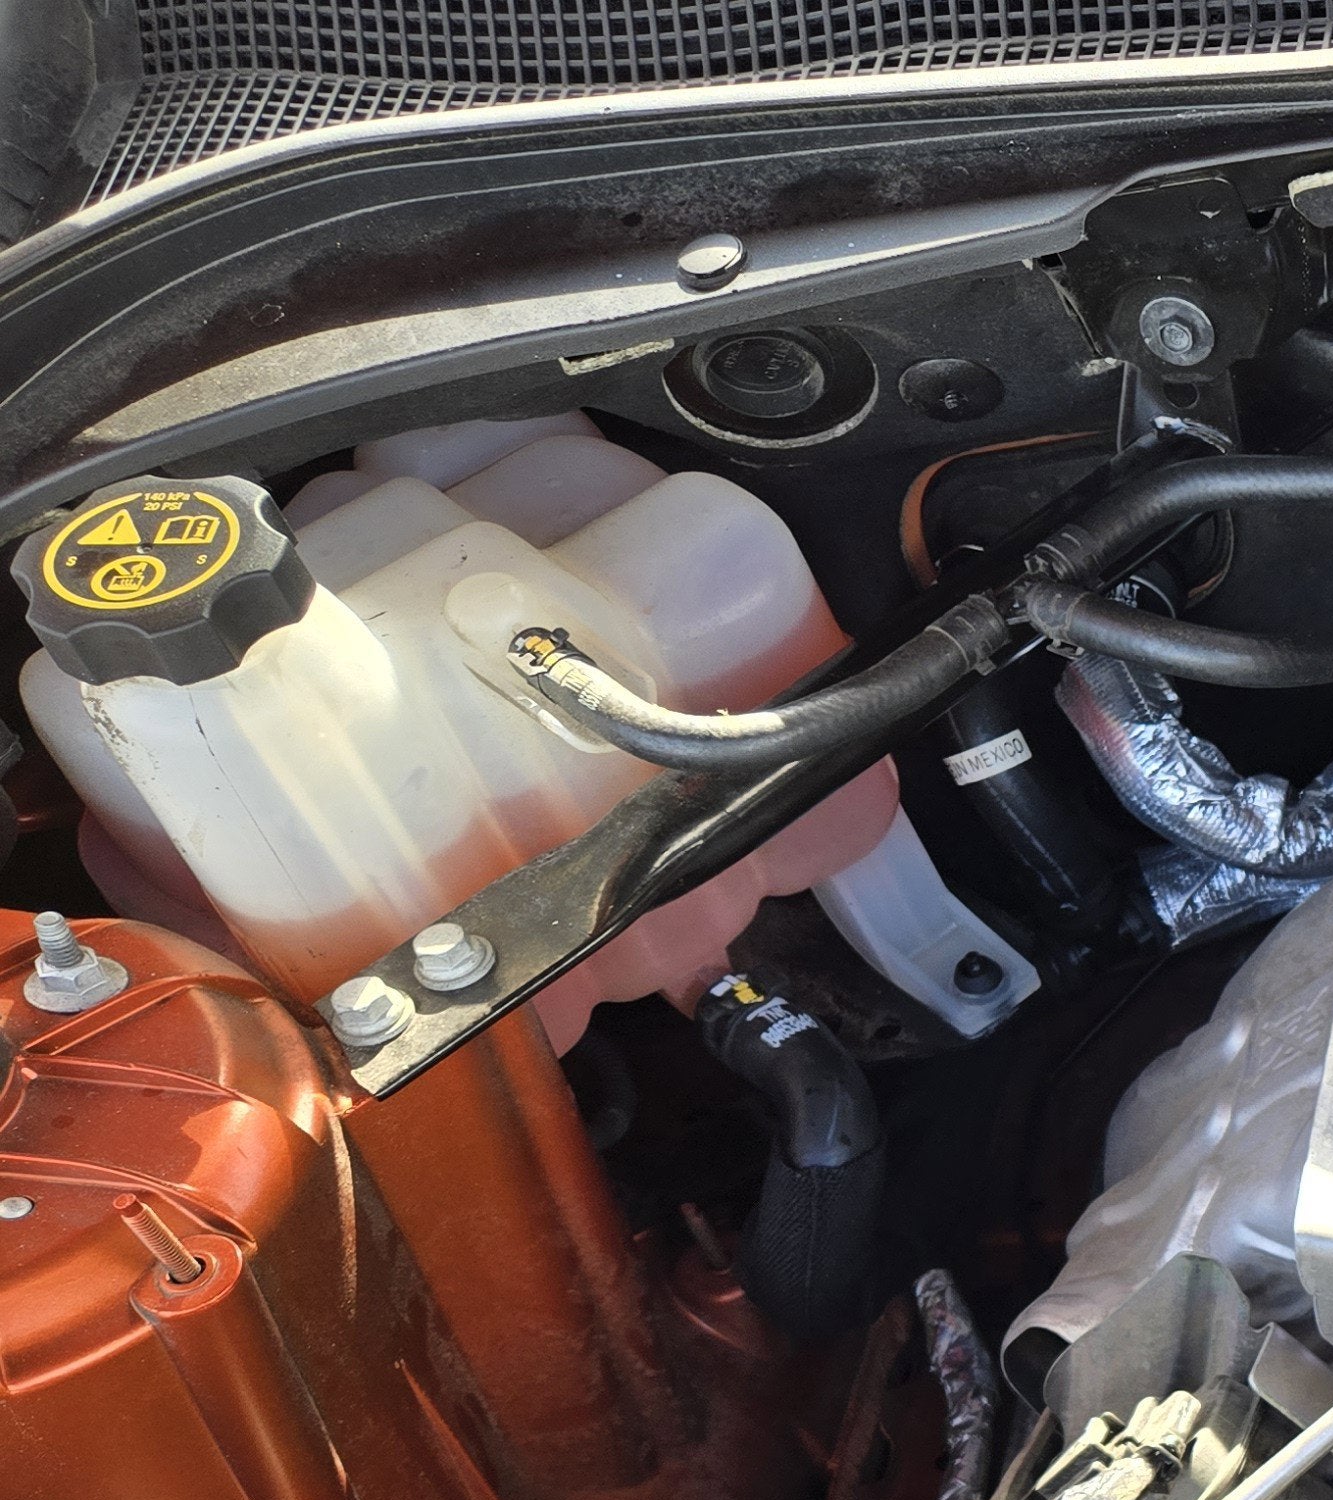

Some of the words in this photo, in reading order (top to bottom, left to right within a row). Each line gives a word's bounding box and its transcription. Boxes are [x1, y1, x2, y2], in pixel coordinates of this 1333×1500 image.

[144, 492, 166, 501] 140
[143, 502, 161, 511] 20
[161, 502, 183, 511] PSI
[967, 737, 1025, 772] MEXICO
